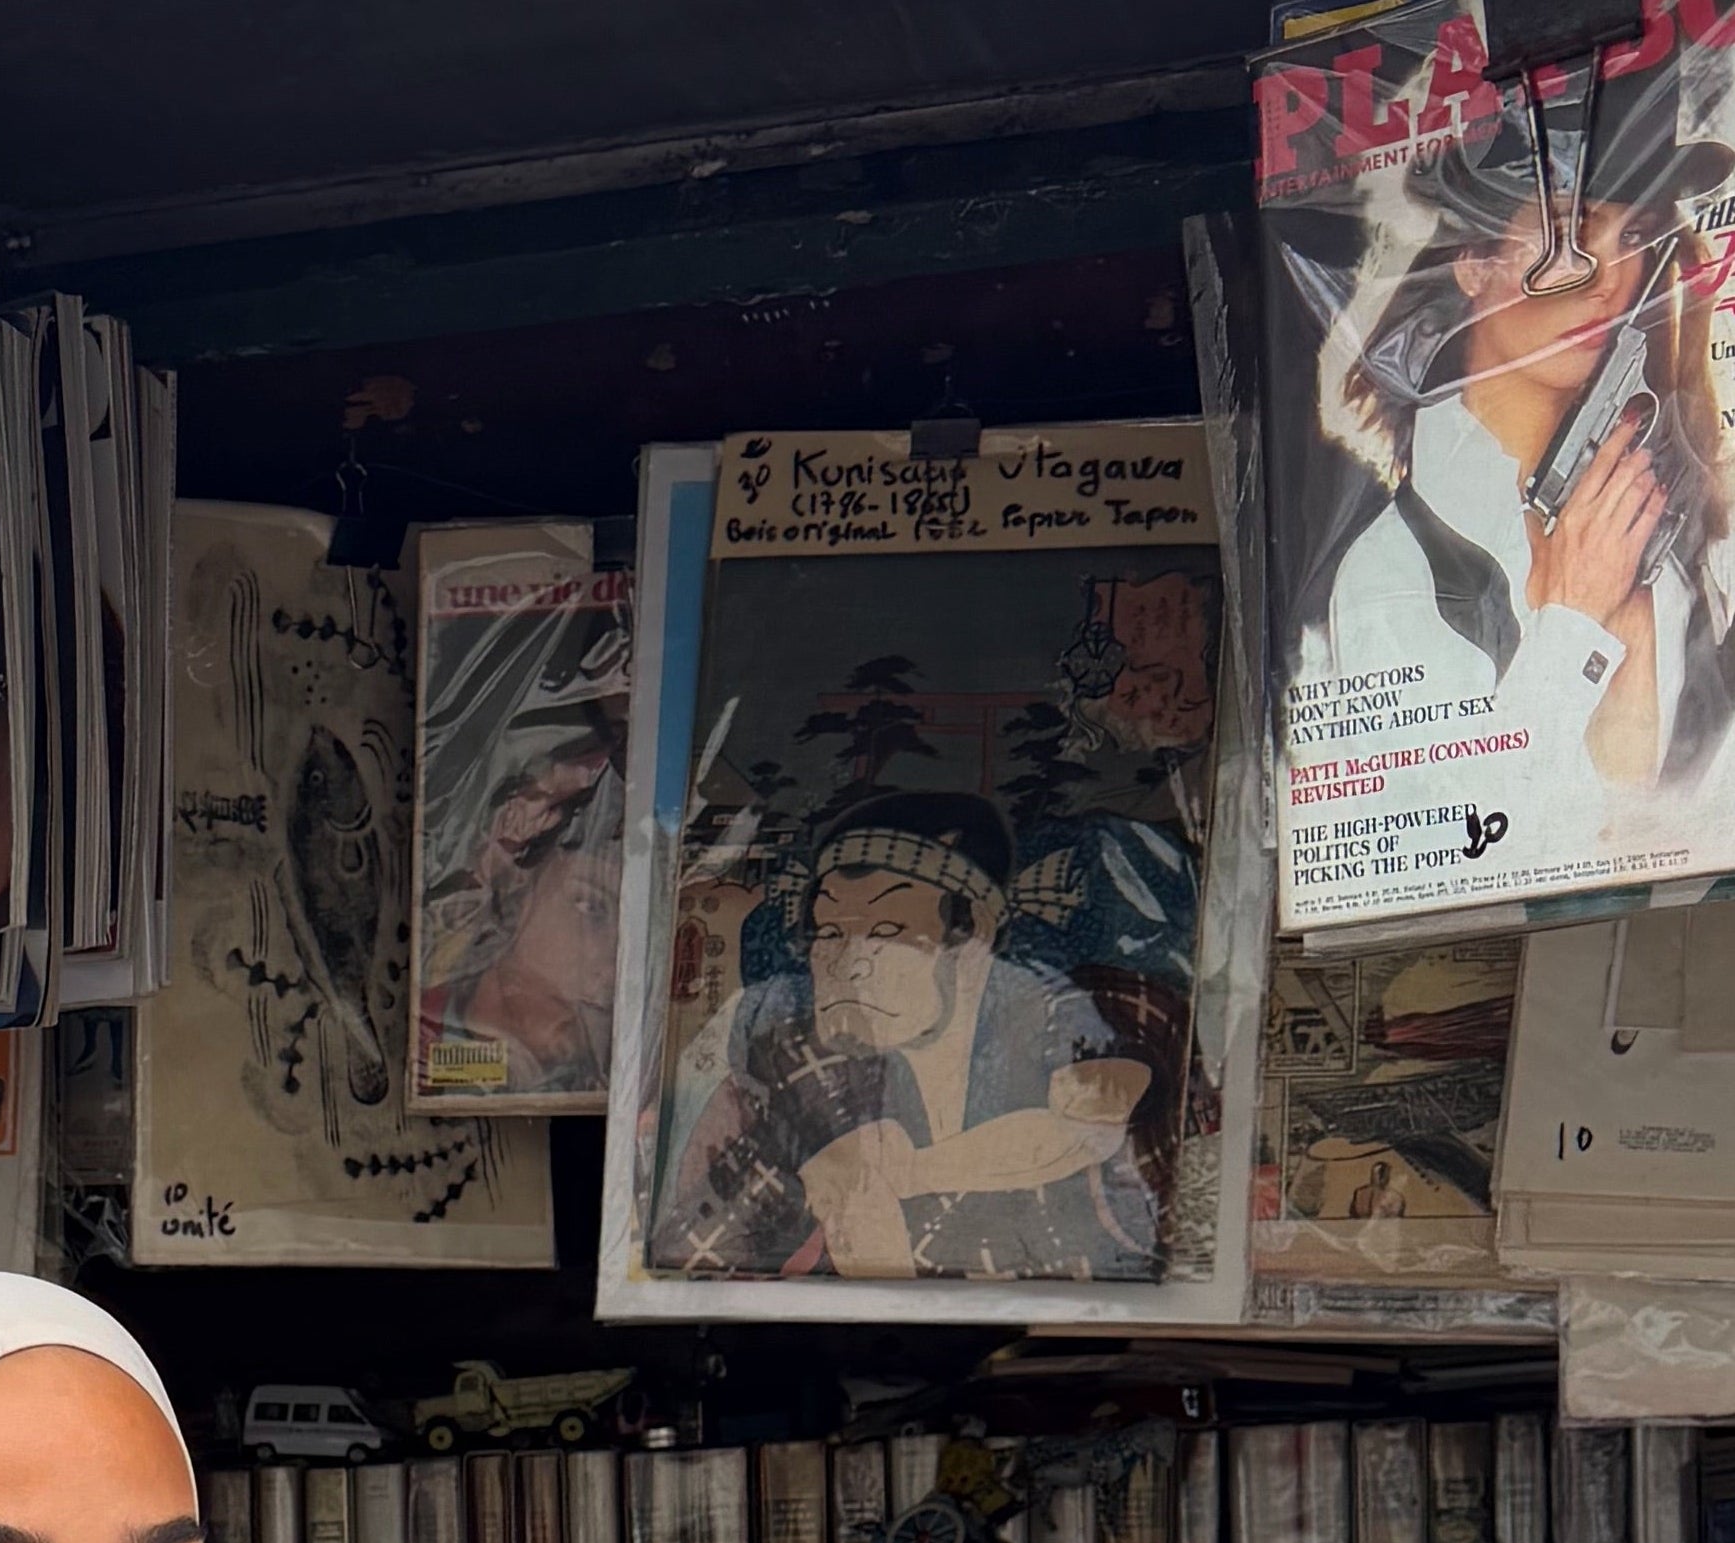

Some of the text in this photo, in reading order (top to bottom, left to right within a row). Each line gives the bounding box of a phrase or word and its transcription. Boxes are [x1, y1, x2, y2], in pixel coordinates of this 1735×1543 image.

[448, 582, 522, 608] une
[1289, 664, 1426, 704] WHY DOCTORS
[1289, 689, 1403, 725] DON'T KNOW
[1290, 695, 1496, 746] ANYTHING ABOUT SEX
[1290, 728, 1531, 787] PATTI McGUIRE (CONNORS)
[1291, 774, 1385, 806] REVISITED
[1293, 824, 1328, 846] THE
[1334, 803, 1477, 839] HIGH-POWERED
[1293, 835, 1400, 866] POLITICS OF
[1294, 848, 1463, 887] PICKING THE POPE
[1557, 1121, 1594, 1161] 10
[164, 1175, 188, 1207] 10
[161, 1195, 236, 1239] unité
